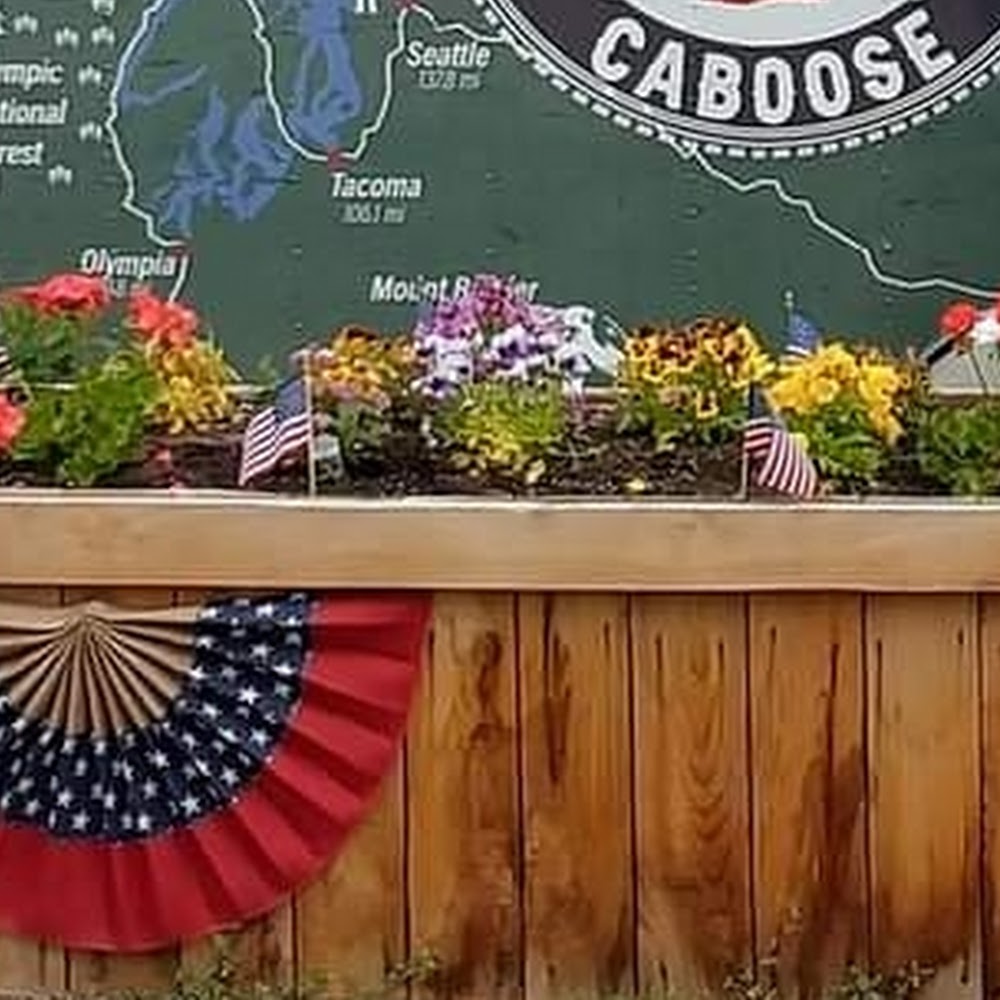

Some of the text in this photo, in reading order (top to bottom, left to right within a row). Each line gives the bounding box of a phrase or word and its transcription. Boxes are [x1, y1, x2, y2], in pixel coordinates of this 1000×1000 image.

[406, 40, 492, 67] Seattle
[591, 9, 957, 125] CABOOSE
[332, 173, 422, 198] Tacoma
[81, 248, 176, 281] Olympia
[370, 275, 448, 302] Mount
